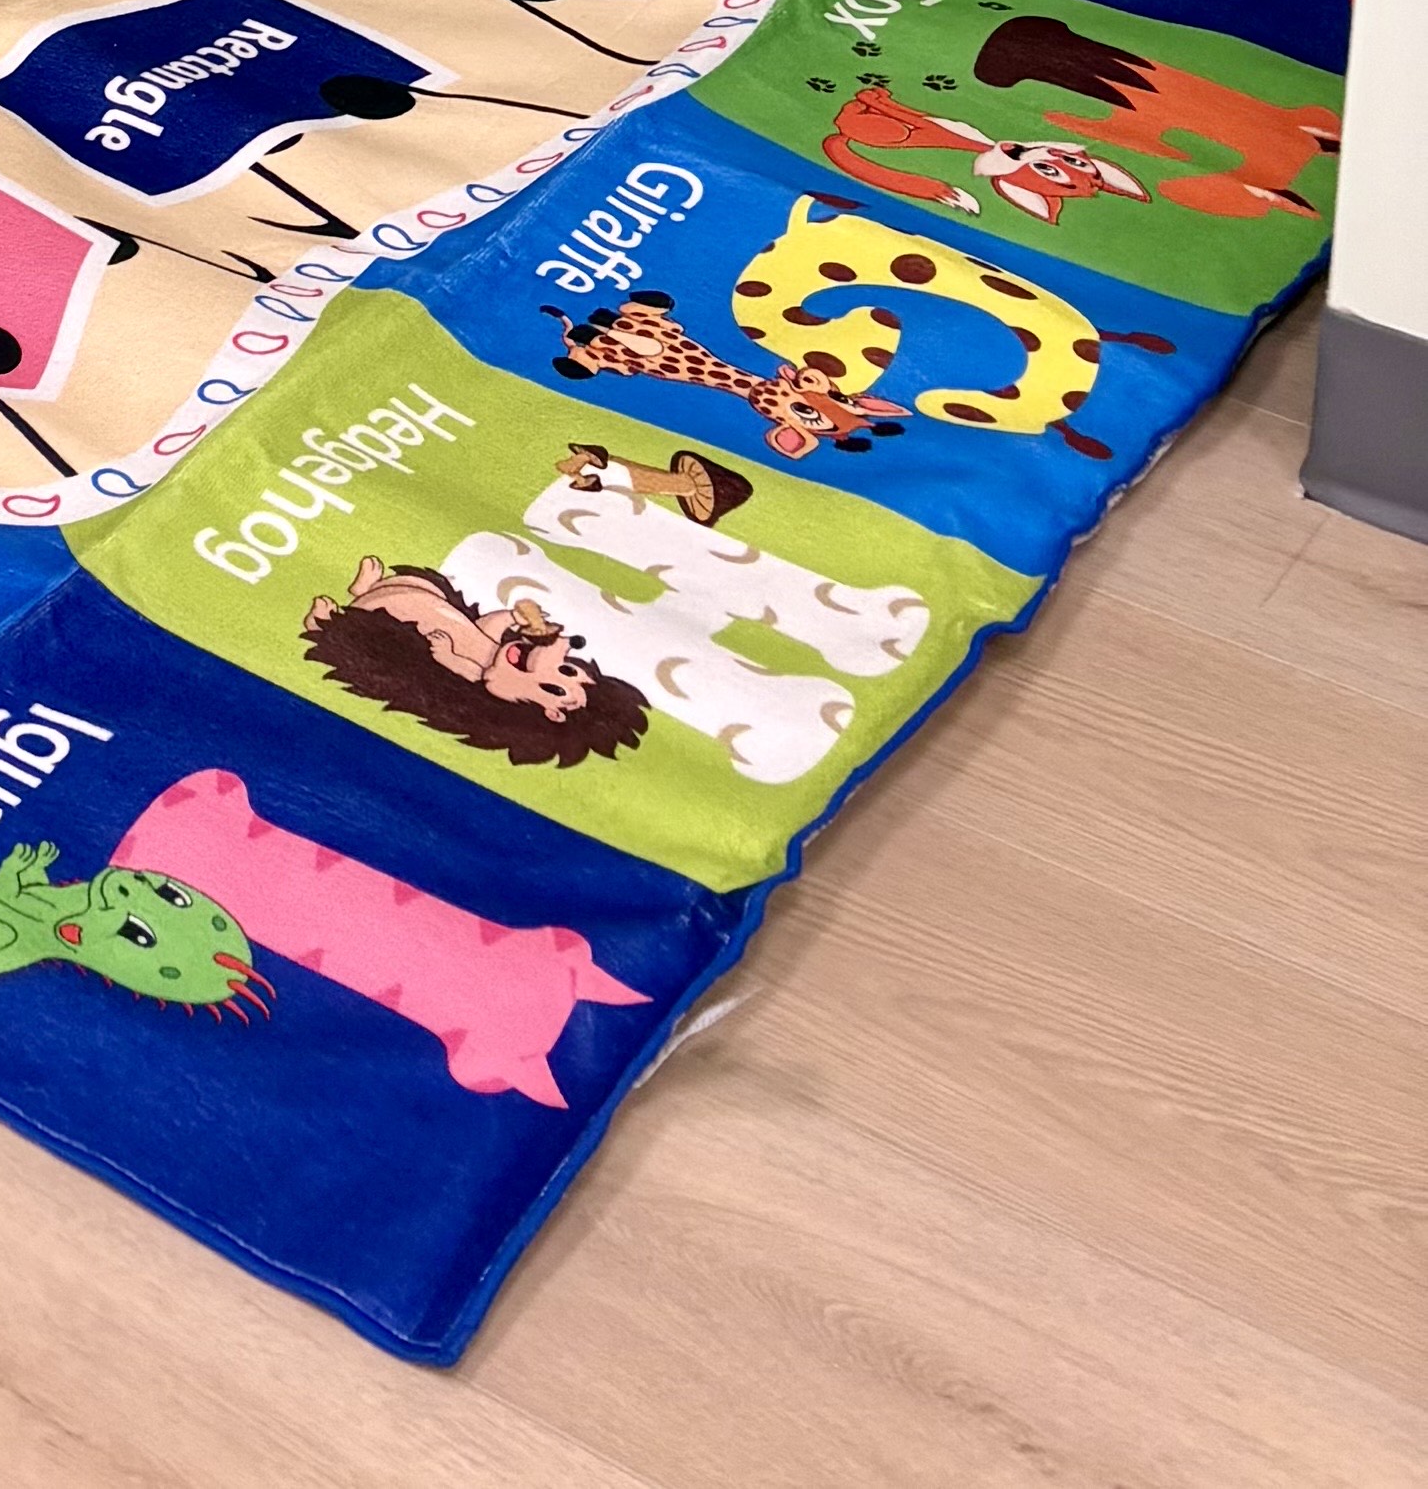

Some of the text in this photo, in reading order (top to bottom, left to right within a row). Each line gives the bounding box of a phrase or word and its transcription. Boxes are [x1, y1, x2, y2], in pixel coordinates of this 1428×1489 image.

[83, 19, 298, 152] Rectangle
[537, 162, 704, 295] Giraffe
[192, 383, 477, 585] Hedgehog
